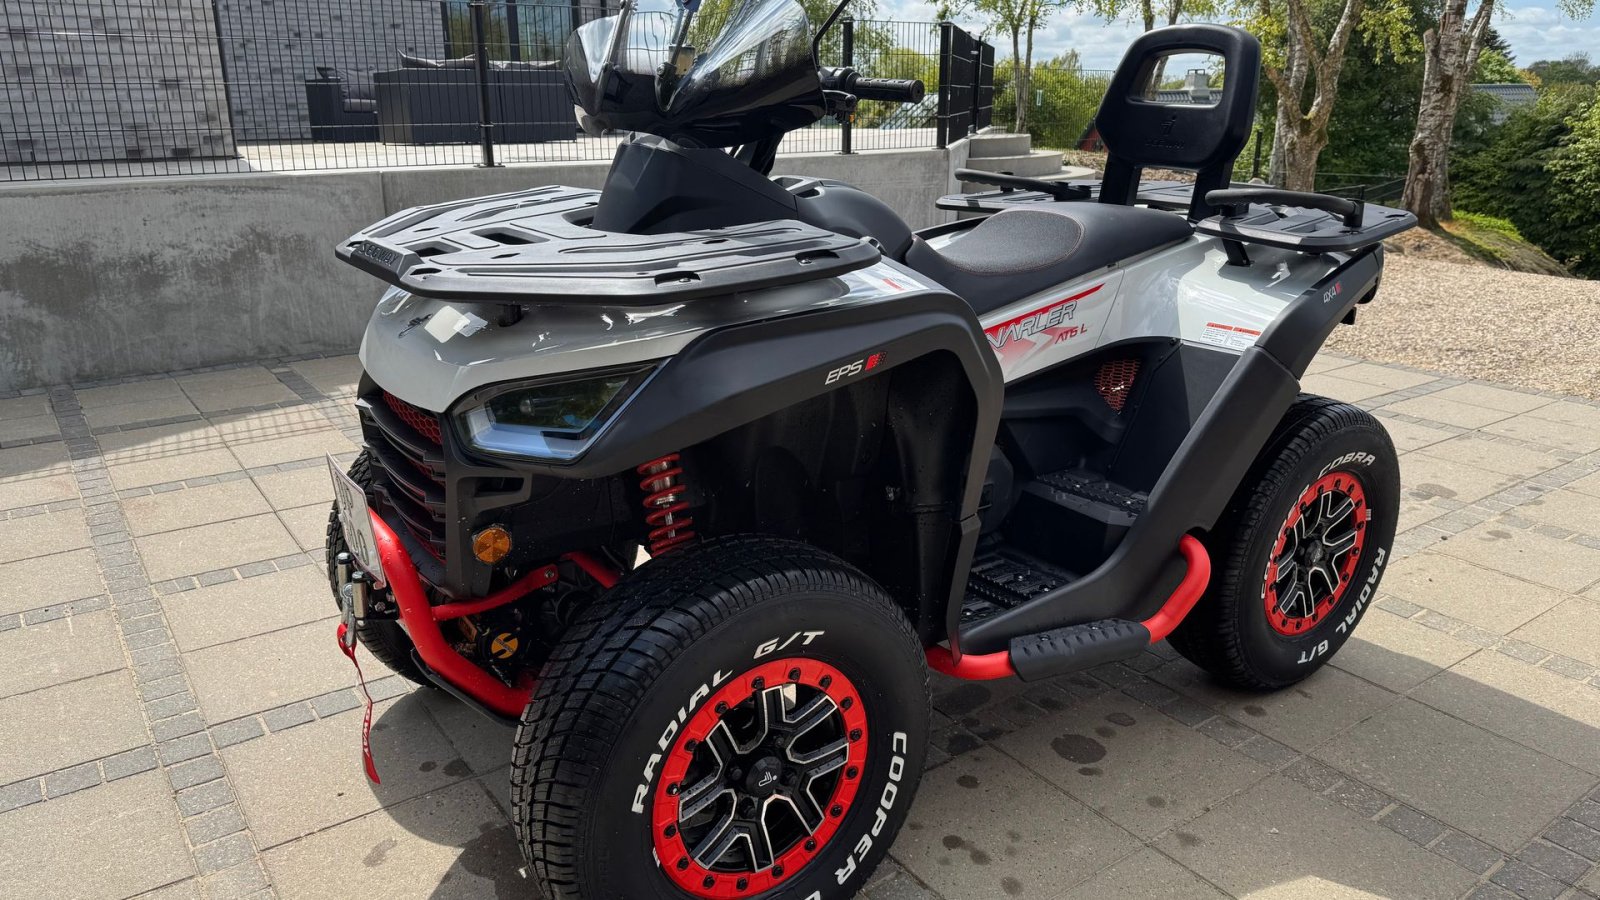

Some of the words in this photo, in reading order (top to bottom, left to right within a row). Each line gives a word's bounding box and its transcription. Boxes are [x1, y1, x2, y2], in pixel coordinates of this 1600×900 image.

[358, 243, 398, 266] SEGWAY
[986, 299, 1078, 350] NARLER
[824, 359, 864, 385] EPS
[1317, 451, 1376, 479] COBRA
[1335, 547, 1386, 634] RADIAL
[1297, 639, 1329, 664] G/T
[631, 669, 733, 814] RADIAL
[753, 630, 825, 659] G/T
[834, 732, 907, 885] COOPER
